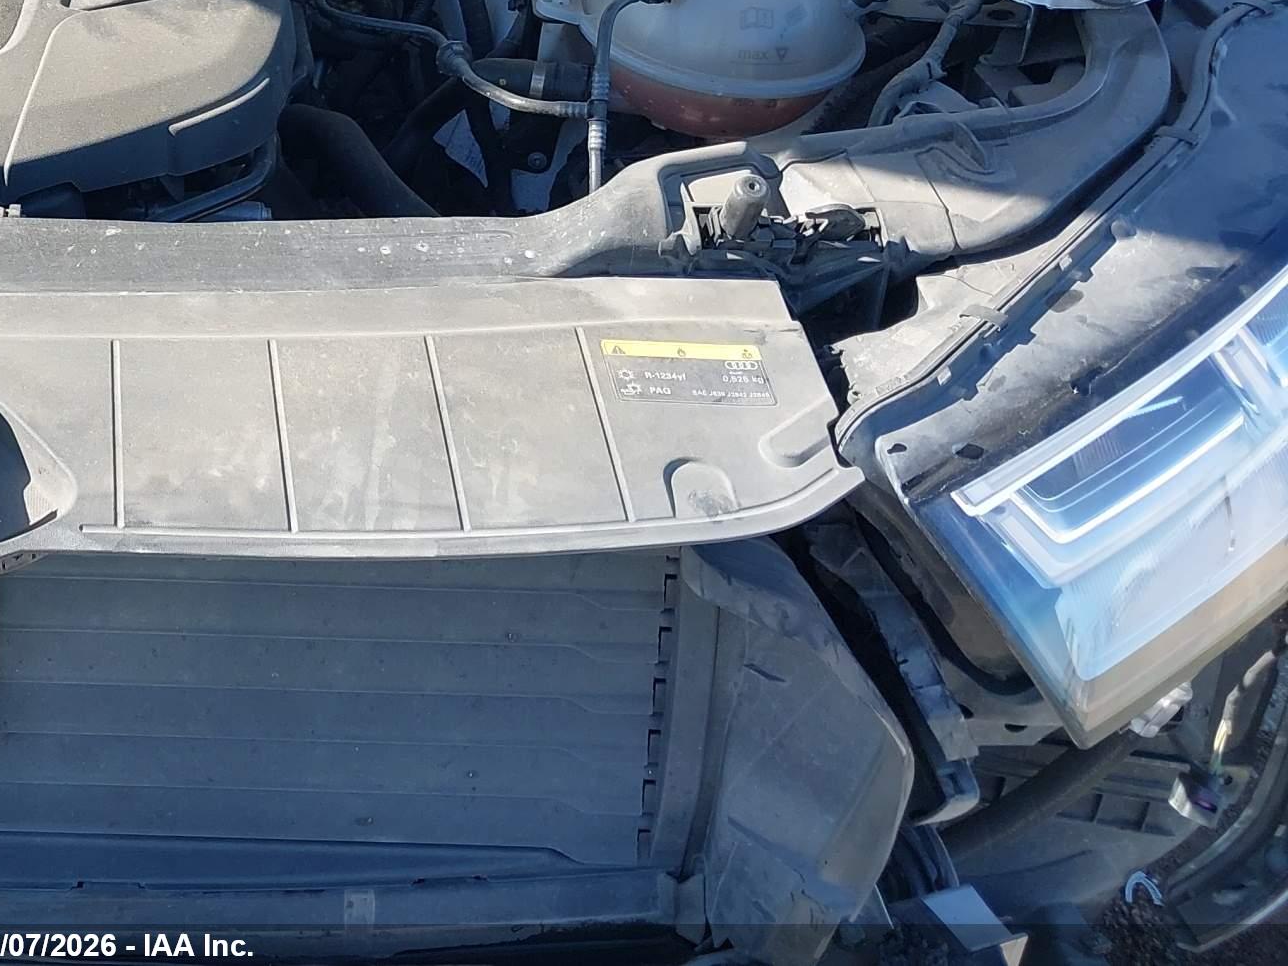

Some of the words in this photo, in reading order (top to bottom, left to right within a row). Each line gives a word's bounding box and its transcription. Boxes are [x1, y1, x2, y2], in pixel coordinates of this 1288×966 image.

[738, 49, 769, 60] max
[644, 371, 687, 382] R-1234yf
[751, 375, 764, 384] kg
[649, 386, 672, 395] PAG
